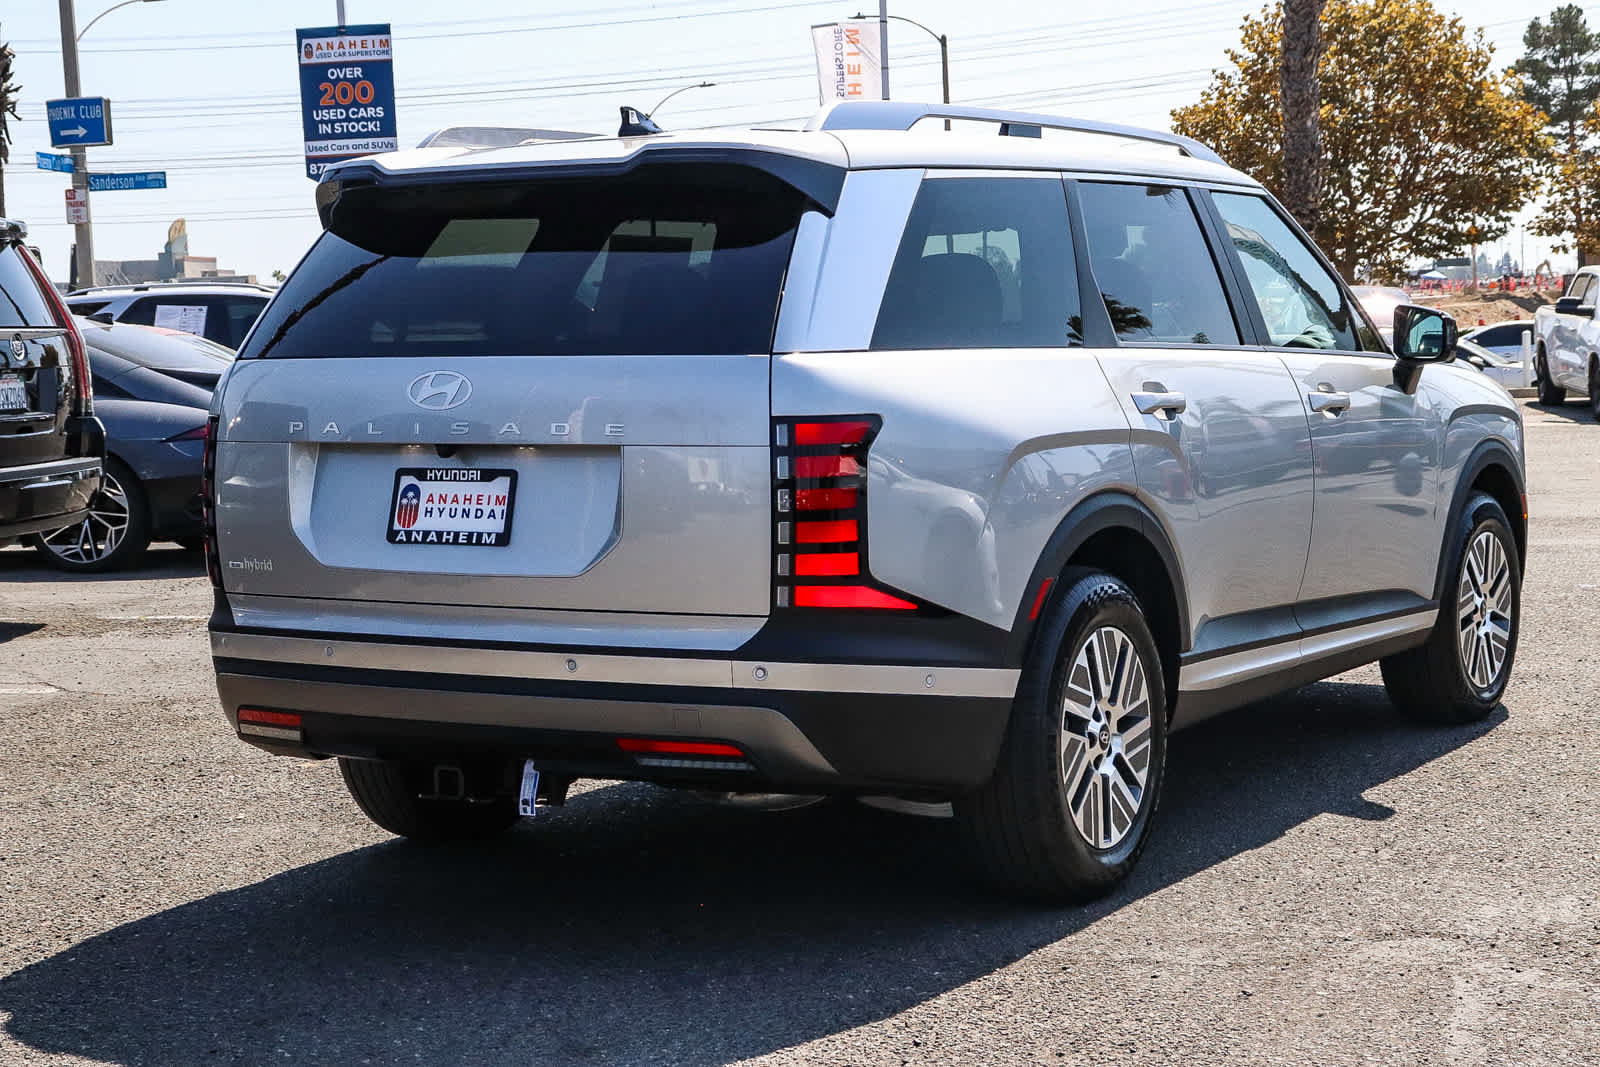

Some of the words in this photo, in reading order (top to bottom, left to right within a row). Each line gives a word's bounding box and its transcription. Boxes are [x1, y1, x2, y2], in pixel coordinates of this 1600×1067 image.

[315, 38, 390, 51] ANAHEIM
[315, 50, 332, 59] USED
[333, 50, 347, 58] CAR
[347, 48, 390, 57] SUPERSTORE
[327, 66, 363, 79] OVER
[319, 80, 375, 106] 200
[79, 104, 102, 119] CLUB
[313, 108, 346, 121] USED
[348, 106, 385, 119] CARS
[318, 123, 332, 134] IN
[334, 120, 381, 133] STOCK!
[307, 143, 329, 153] Used
[330, 143, 350, 151] Cars
[351, 142, 370, 150] and
[371, 141, 394, 150] SUVs
[89, 175, 135, 190] Sanderson
[288, 421, 625, 437] PALISADE
[426, 469, 481, 481] HYUNDAI
[425, 493, 507, 506] ANAHEIM
[424, 507, 505, 520] HYUNDAI
[395, 530, 497, 545] ANAHEIM
[243, 557, 273, 574] hybrid
